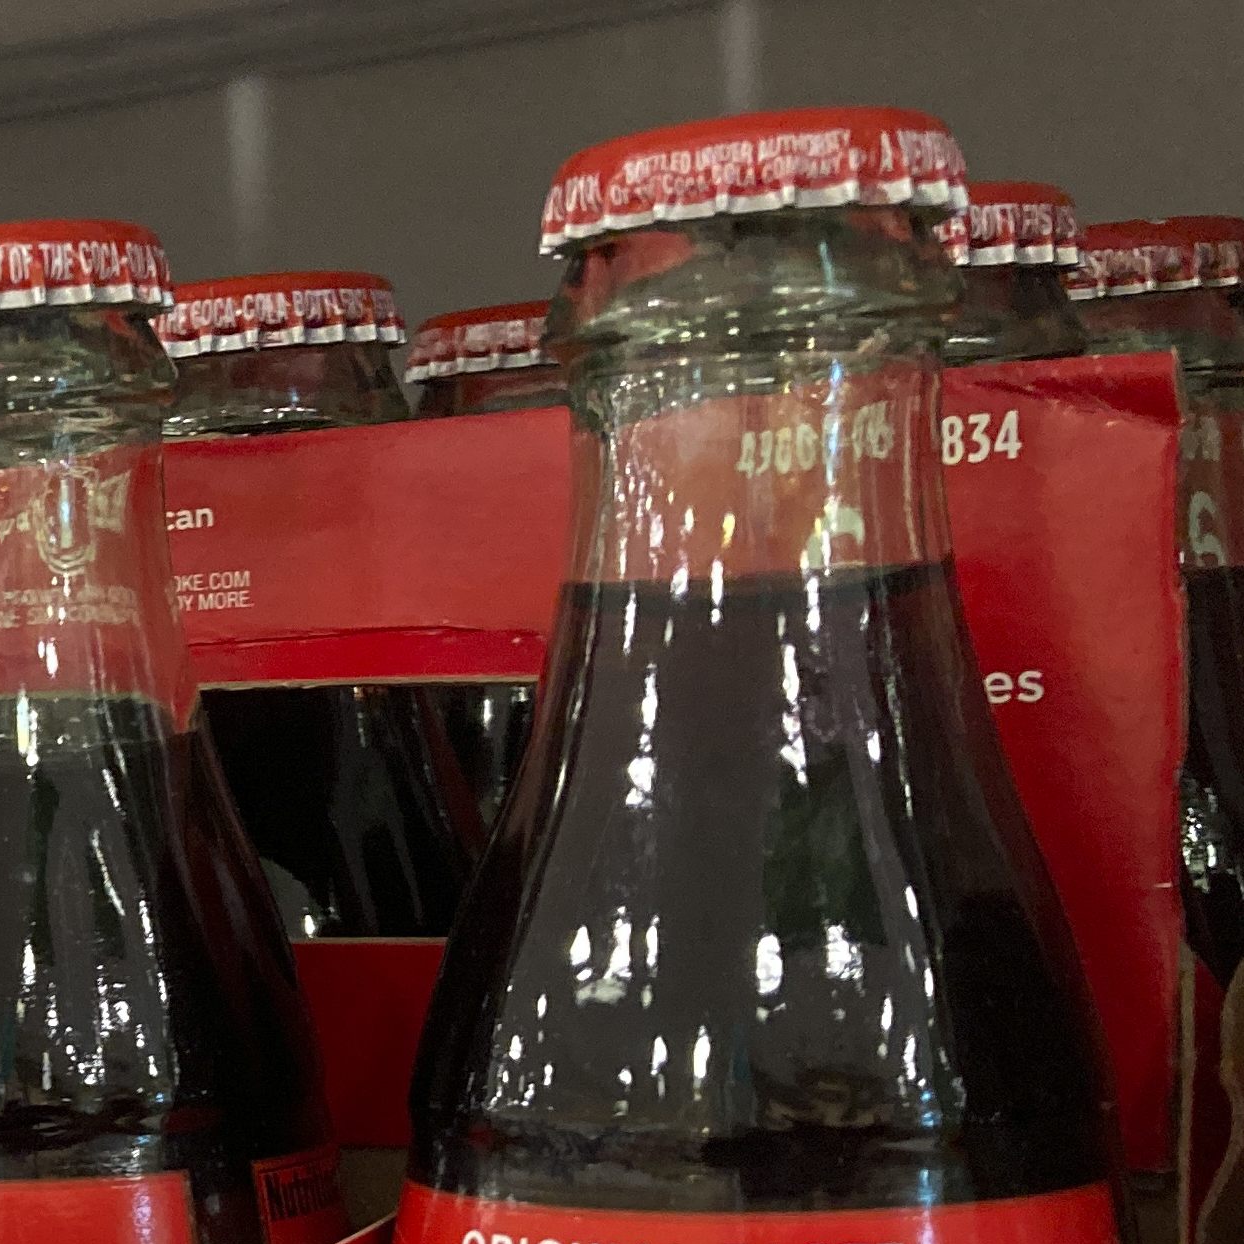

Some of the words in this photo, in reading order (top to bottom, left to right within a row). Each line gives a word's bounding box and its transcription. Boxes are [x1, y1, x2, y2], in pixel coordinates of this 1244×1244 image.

[624, 151, 690, 185] BOTTLED
[695, 141, 752, 172] UNDER
[758, 128, 851, 161] AUTHORITY
[9, 243, 33, 284] OF
[39, 242, 73, 281] THE
[941, 410, 1022, 466] 834
[983, 670, 1045, 704] es
